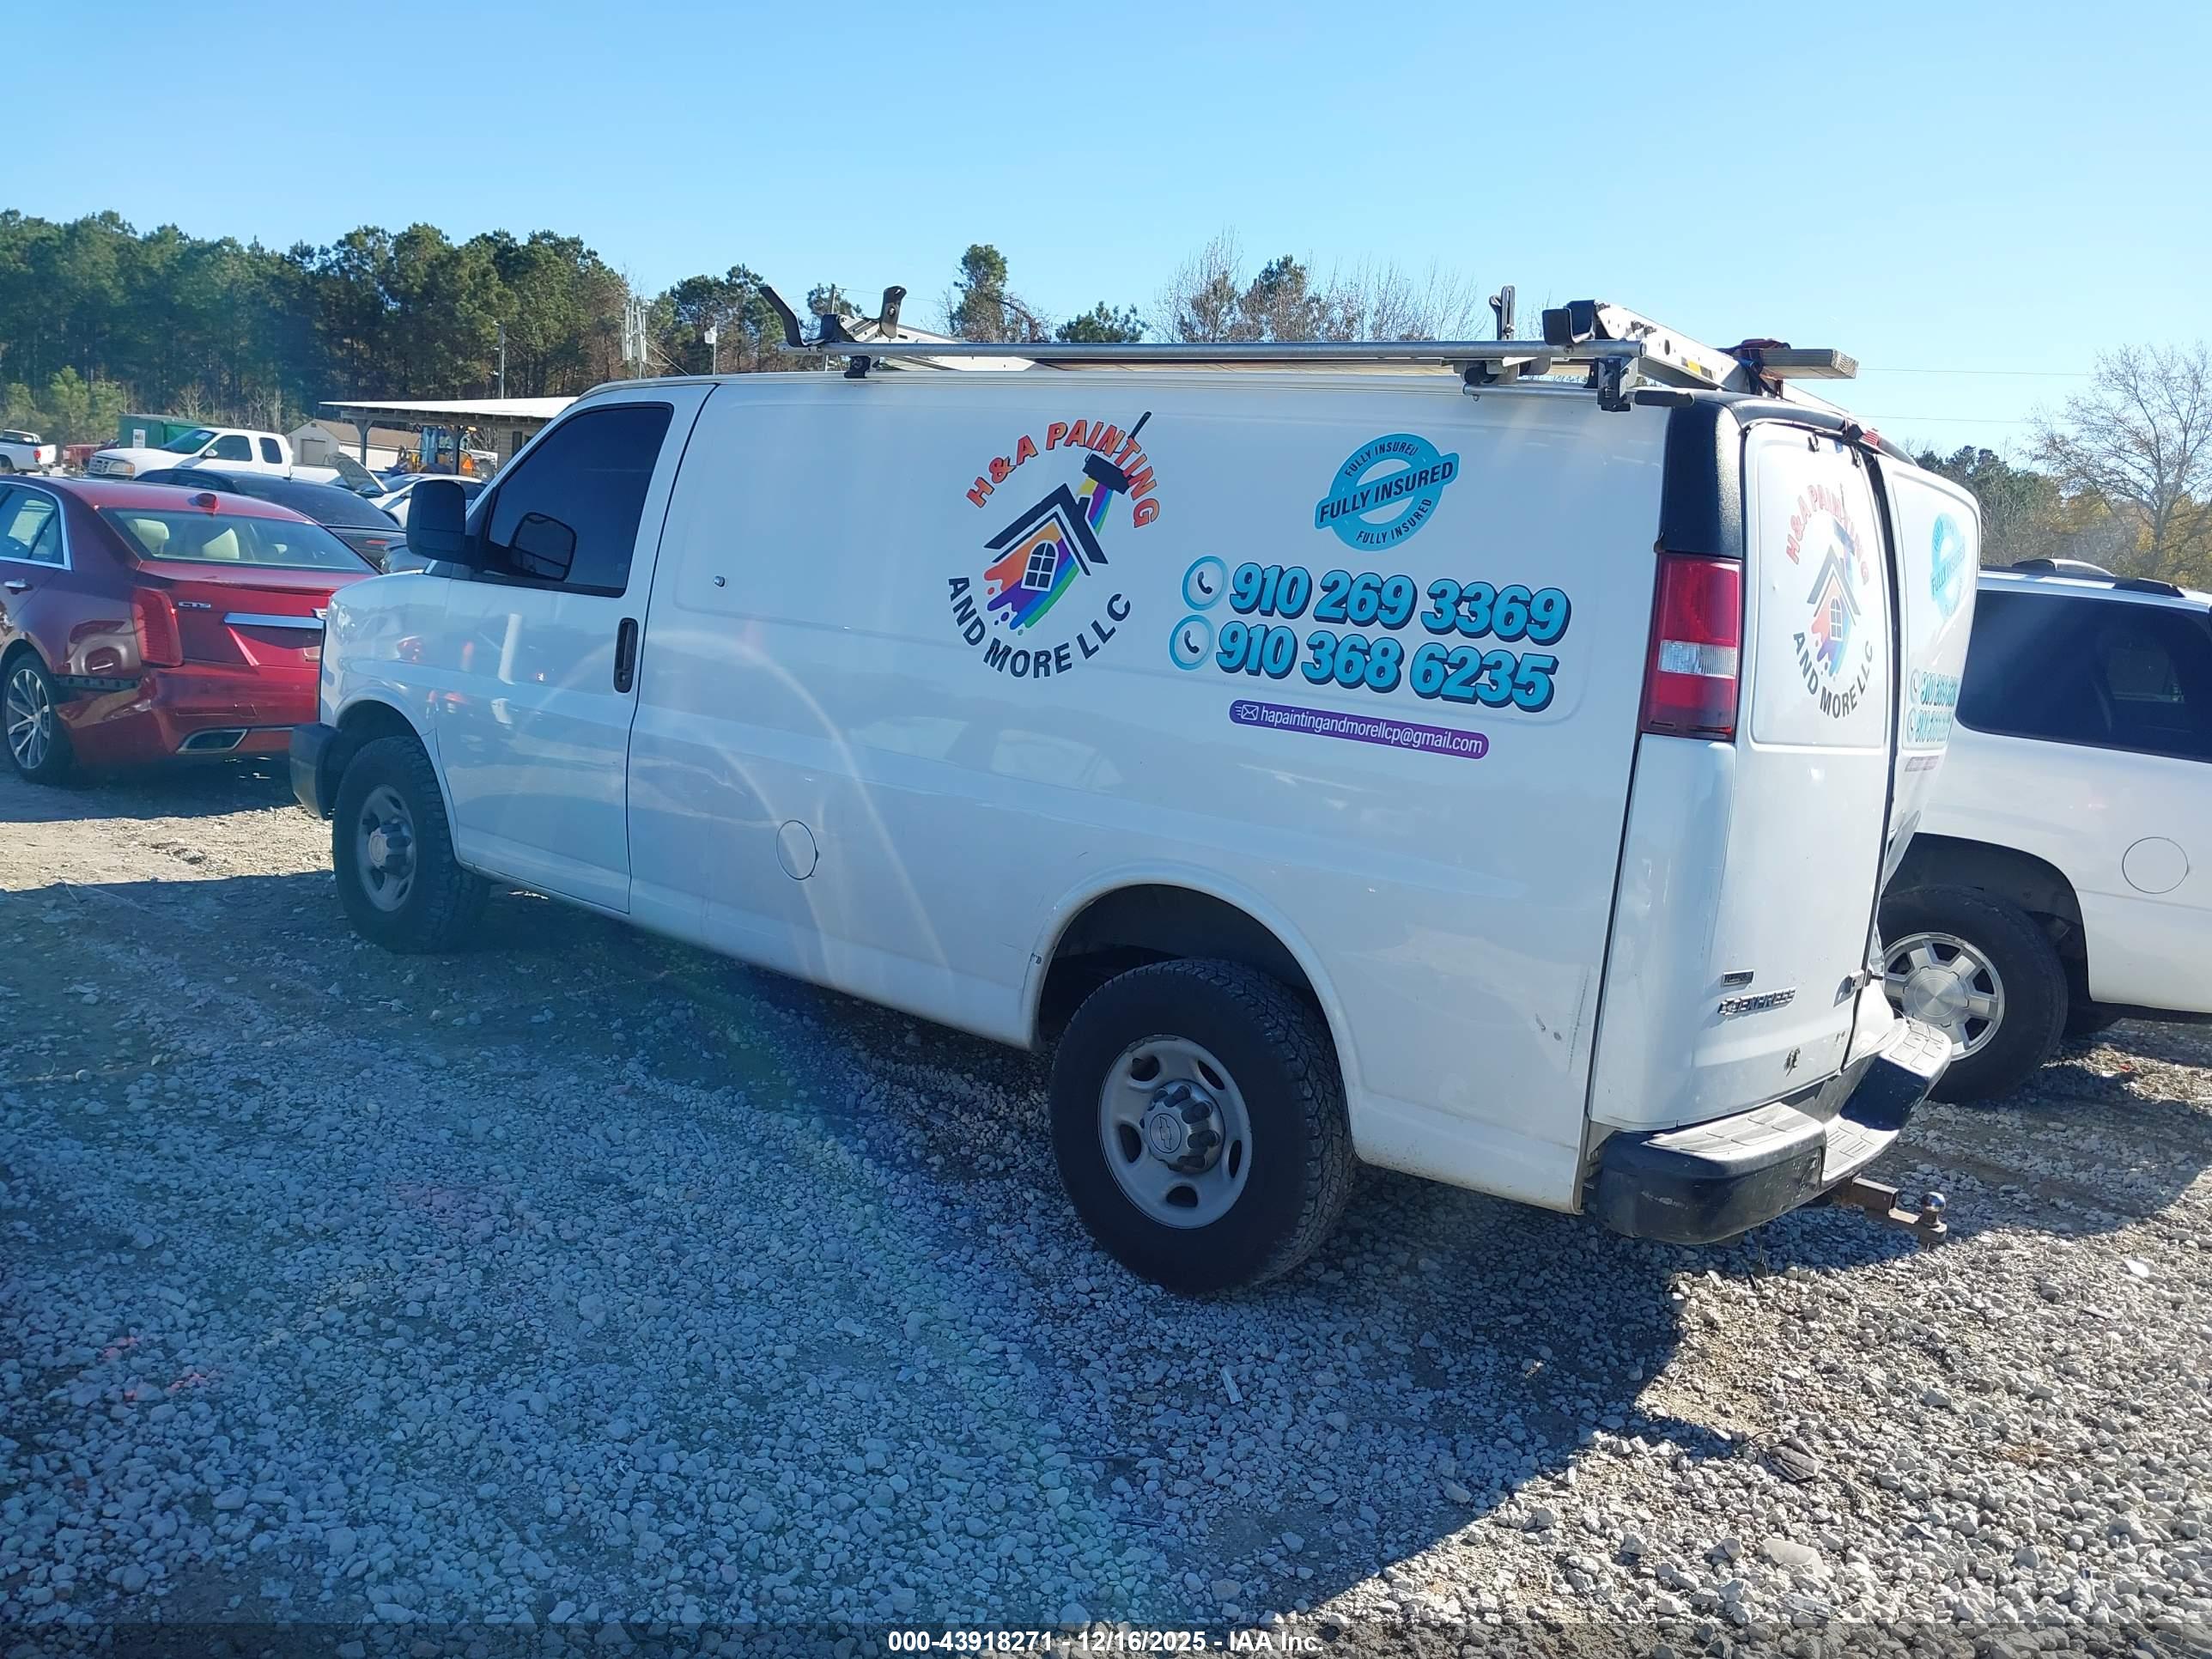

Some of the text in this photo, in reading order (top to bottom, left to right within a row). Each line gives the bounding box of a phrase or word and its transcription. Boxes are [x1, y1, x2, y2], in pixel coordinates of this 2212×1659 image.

[965, 419, 1160, 528] H&A PAINTING
[1319, 461, 1454, 523] FULLY INSURED
[1345, 441, 1419, 477] FULLY INSURED
[1356, 498, 1432, 544] FULLY INSURED
[948, 576, 1131, 679] AND MORE LLC
[1230, 562, 1571, 647] 910 269 3369
[1216, 620, 1559, 714] 910 368 6235
[1793, 631, 1873, 719] AND MORE LLC
[1261, 706, 1483, 754] hapaintingandmorellcp@gmail.com
